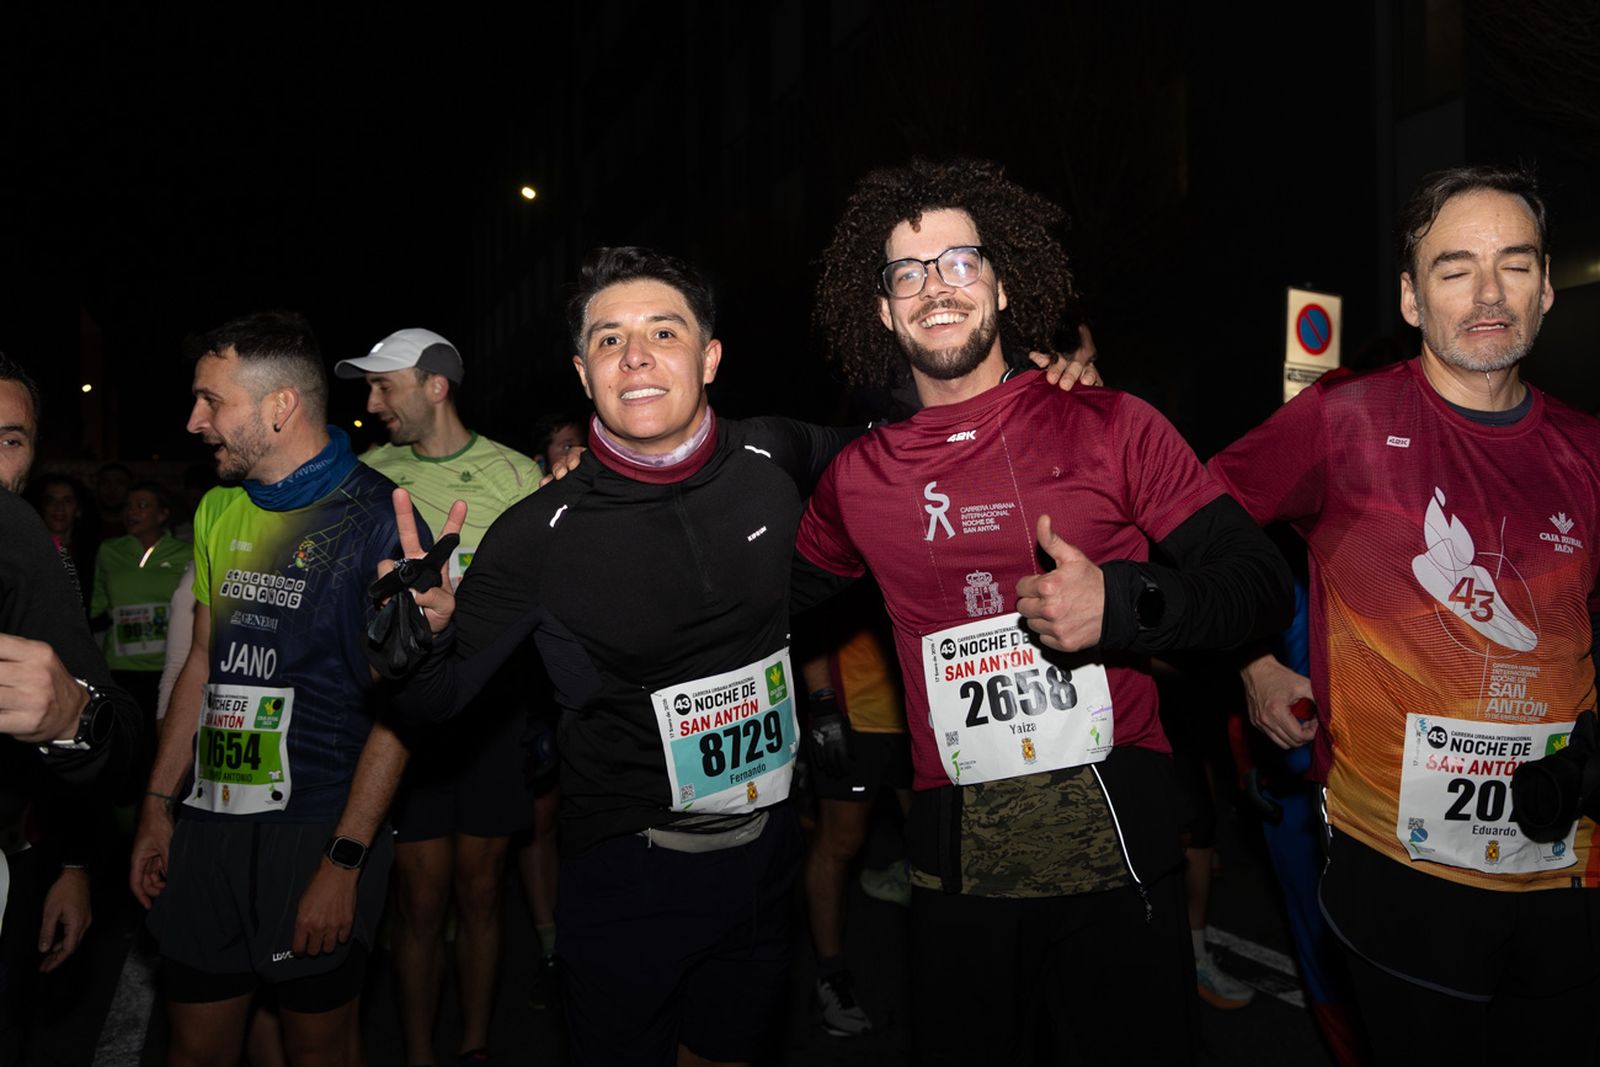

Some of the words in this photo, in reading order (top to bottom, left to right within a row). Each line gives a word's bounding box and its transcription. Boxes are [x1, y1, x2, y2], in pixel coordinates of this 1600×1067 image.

[960, 505, 988, 513] CARRERA
[989, 502, 1016, 510] URBANA
[961, 510, 1009, 520] INTERNACIONAL
[962, 519, 985, 527] NOCHE
[977, 523, 1000, 532] ANTÓN
[1539, 531, 1560, 542] CAJA
[1448, 576, 1495, 623] 43
[957, 634, 976, 643] CARRERA
[959, 634, 1007, 658] NOCHE
[941, 642, 955, 654] 43
[220, 641, 277, 680] JANO
[945, 660, 975, 682] SAN
[979, 647, 1034, 675] ANTÓN
[694, 687, 739, 713] NOCHE
[742, 681, 757, 699] DE
[959, 665, 1078, 728] 2658
[1488, 681, 1526, 699] SAN
[233, 700, 249, 712] DE
[675, 696, 690, 711] 43
[1485, 697, 1548, 717] ANTÓN
[214, 711, 245, 729] ANTÓN
[680, 715, 711, 737] SAN
[714, 698, 759, 728] ANTÓN
[1009, 721, 1037, 735] Yaiza
[1429, 730, 1447, 744] 43
[1451, 730, 1473, 738] CARRERA
[699, 709, 784, 778] 8729
[1450, 738, 1508, 756] NOCHE
[1510, 742, 1532, 757] DE
[730, 761, 767, 785] Fernando
[1426, 754, 1464, 774] SAN
[1444, 777, 1518, 823] 20
[1472, 824, 1517, 837] Eduardo
